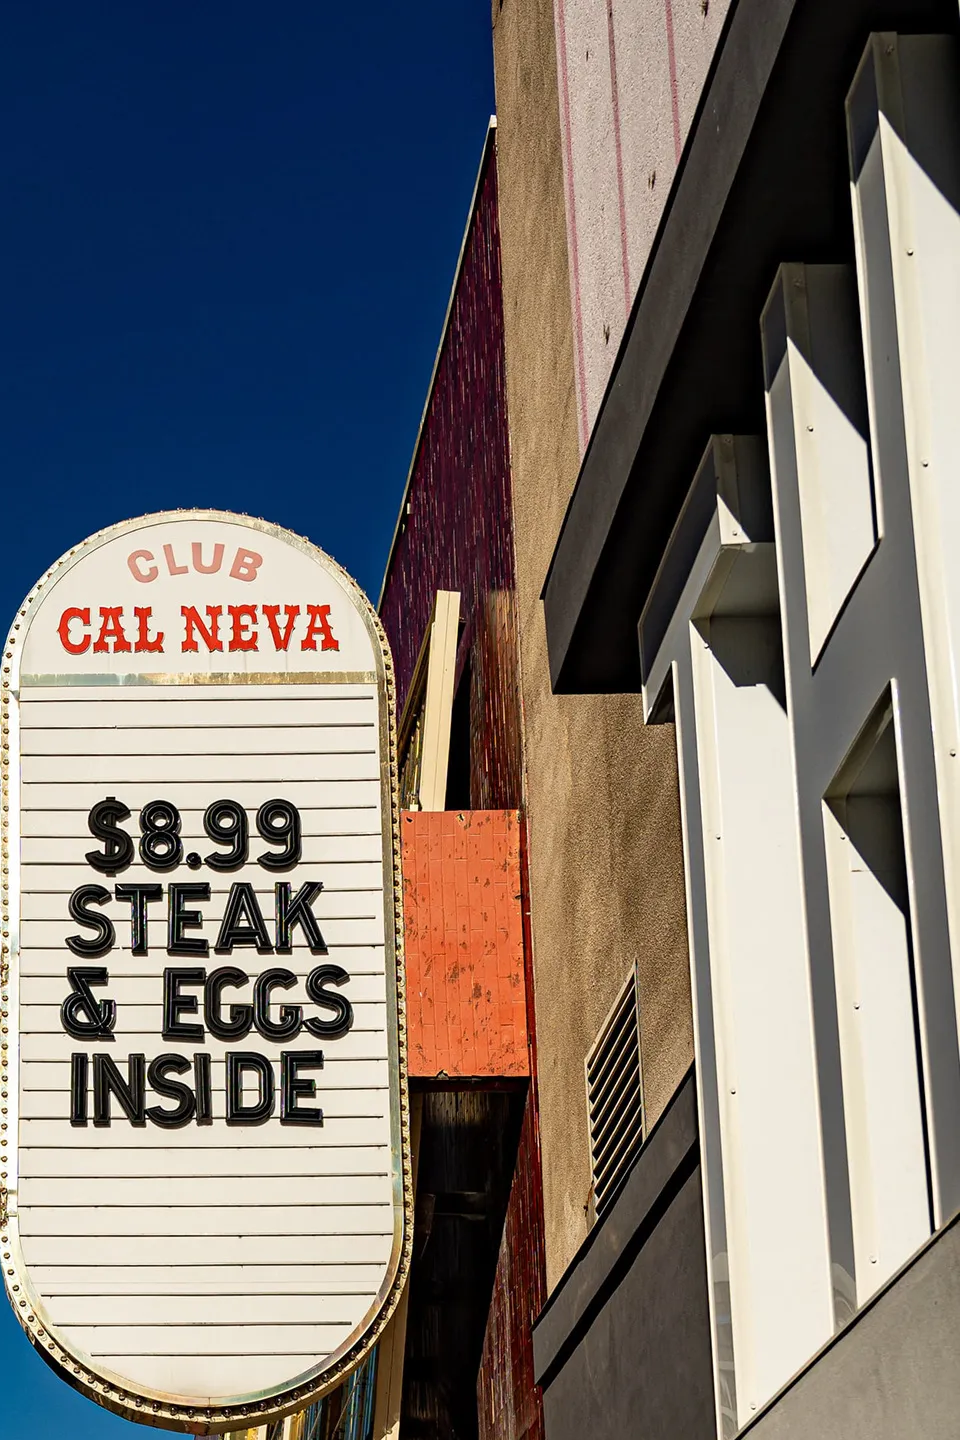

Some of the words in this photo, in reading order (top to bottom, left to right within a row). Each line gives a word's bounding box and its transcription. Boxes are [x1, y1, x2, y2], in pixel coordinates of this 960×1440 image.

[127, 542, 263, 583] CLUB
[57, 606, 165, 655] CAL
[181, 604, 340, 653] NEVA
[85, 797, 303, 877] $8.99
[65, 881, 330, 959] STEAK
[60, 966, 117, 1042] &
[162, 963, 355, 1044] EGGS
[70, 1050, 324, 1129] INSIDE
